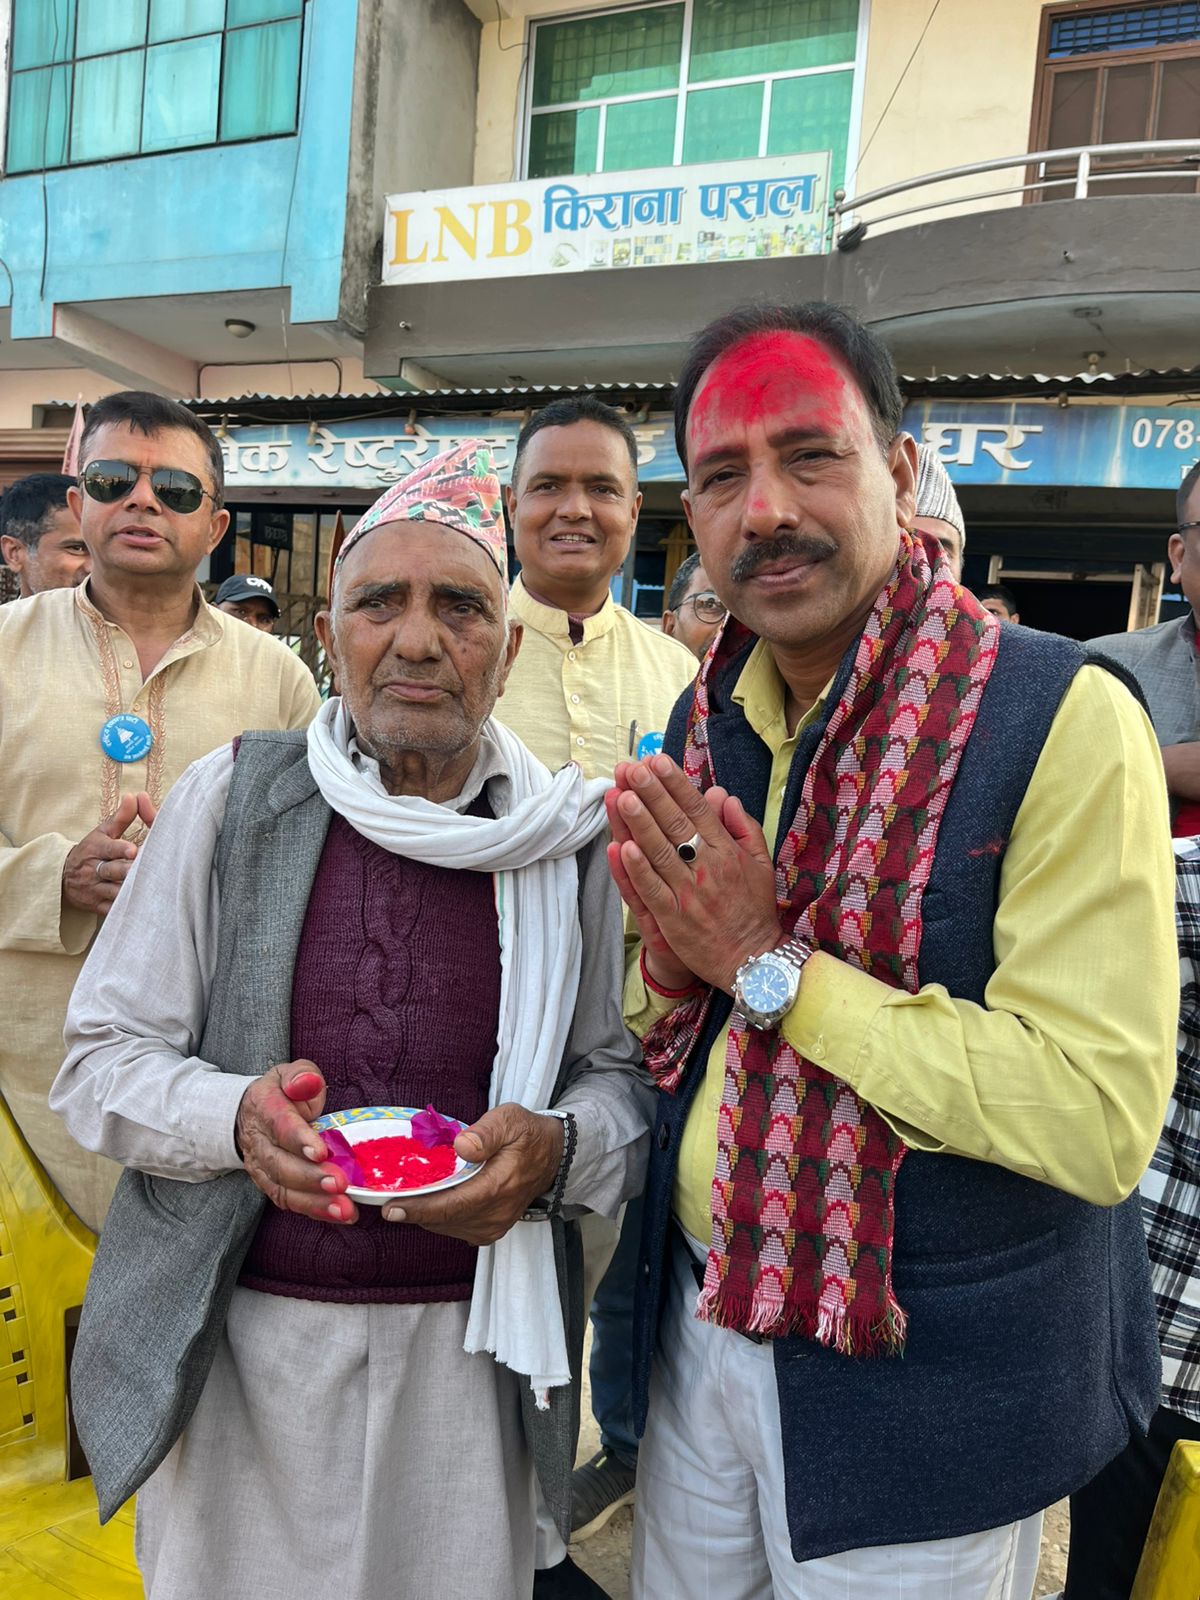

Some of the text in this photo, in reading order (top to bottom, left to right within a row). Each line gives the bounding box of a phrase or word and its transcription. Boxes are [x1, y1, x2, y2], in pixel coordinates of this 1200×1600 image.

[389, 199, 532, 267] LNB
[543, 174, 820, 233] किराना पसल
